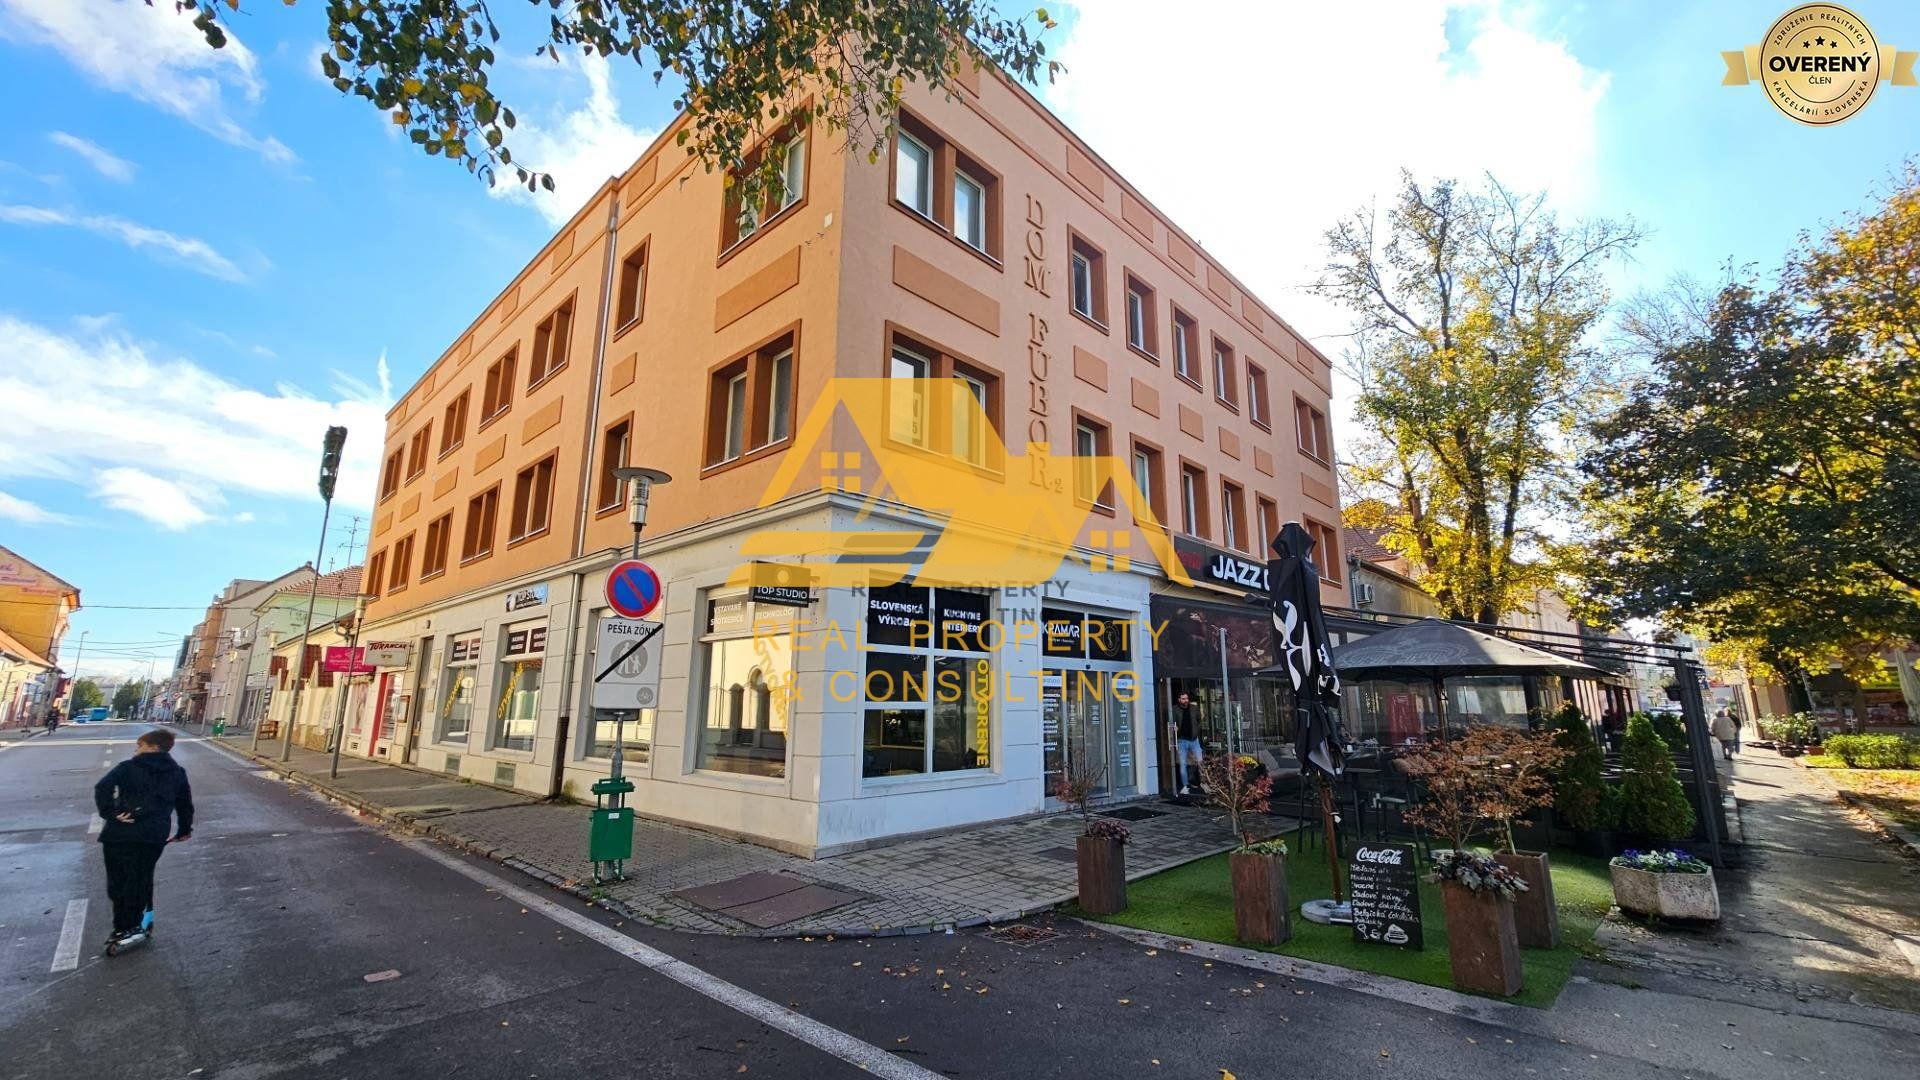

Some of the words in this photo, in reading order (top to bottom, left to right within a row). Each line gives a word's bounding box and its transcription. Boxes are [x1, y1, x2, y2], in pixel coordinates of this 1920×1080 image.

[1024, 193, 1051, 298] DOM
[1212, 555, 1262, 589] JAZZ
[756, 585, 775, 595] TOP
[776, 588, 808, 599] STUDIO
[870, 600, 924, 614] SLOVENSKÁ
[878, 613, 917, 627] VÝROBA
[607, 621, 632, 635] PEŠIA
[634, 624, 656, 636] ZÓNA
